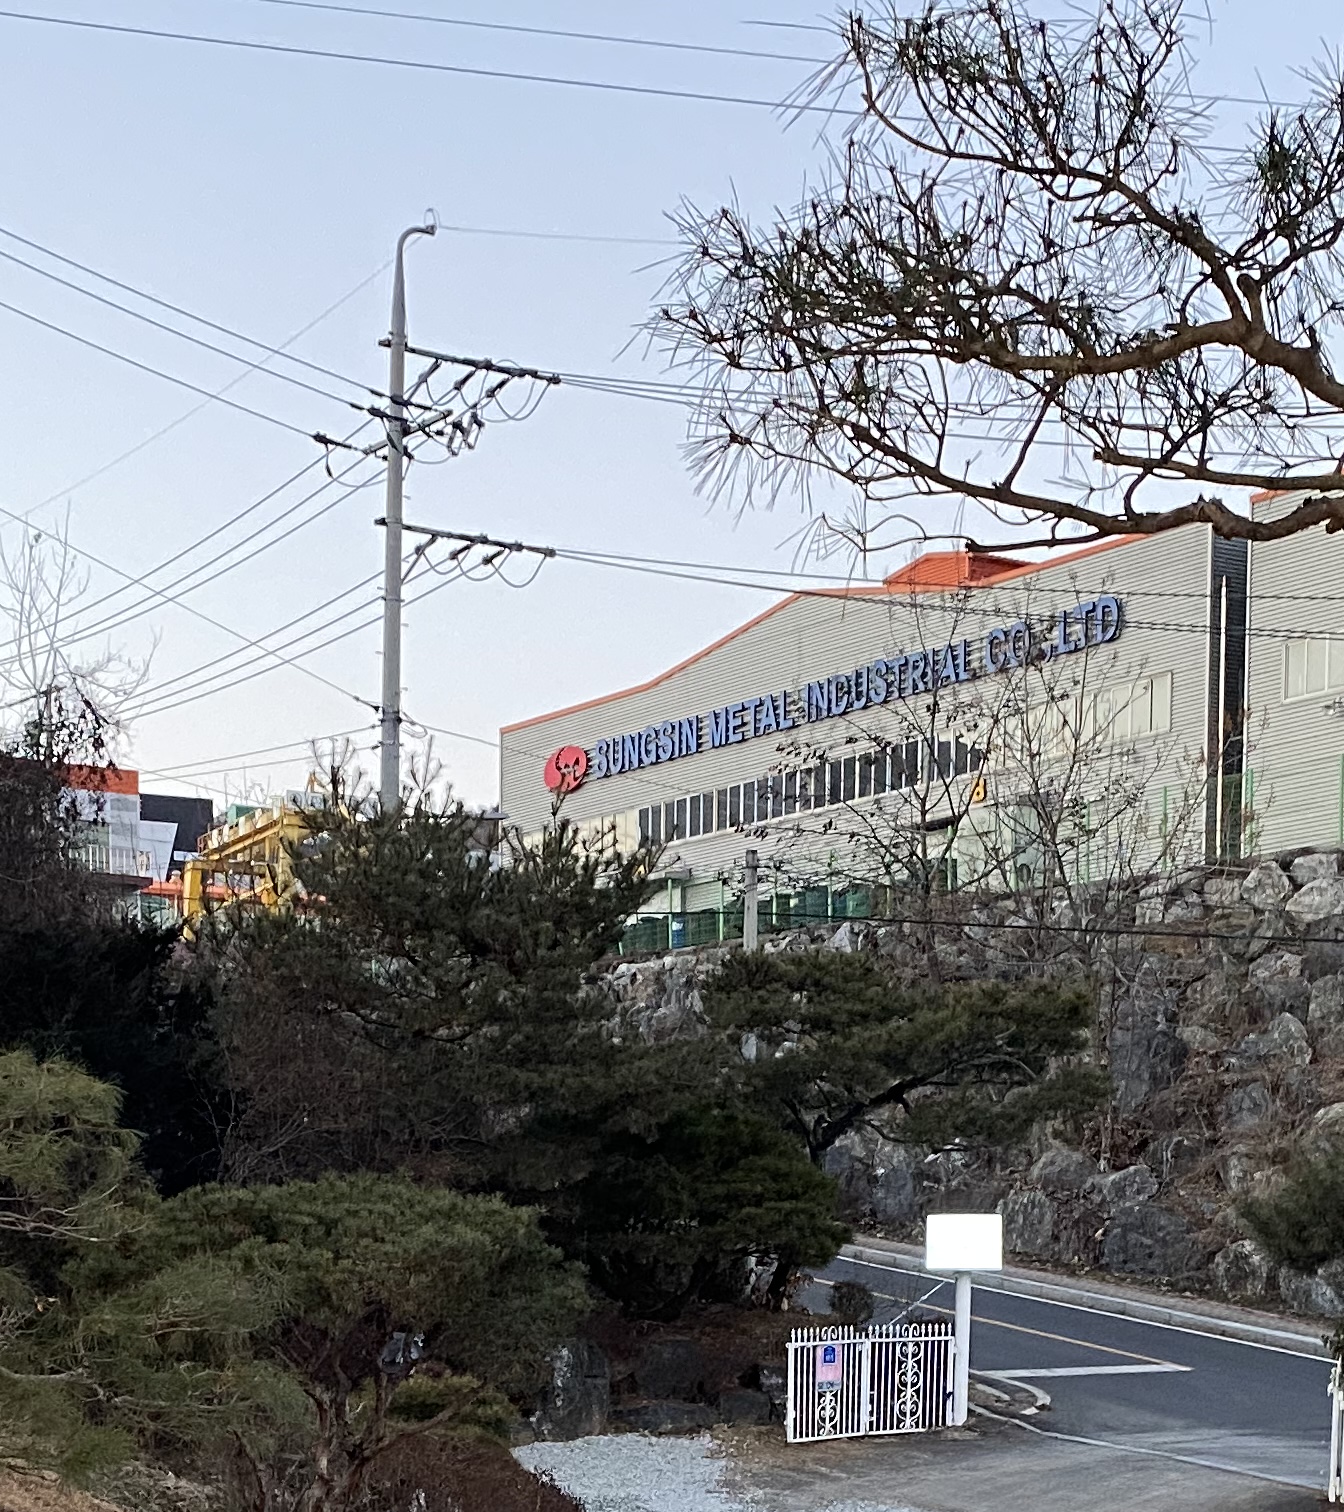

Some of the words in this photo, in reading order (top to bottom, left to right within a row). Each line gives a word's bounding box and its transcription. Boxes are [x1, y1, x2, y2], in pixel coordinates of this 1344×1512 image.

[593, 715, 699, 779] SUNGSIN
[709, 689, 795, 749] METAL
[801, 639, 972, 722] INDUSTRIAL
